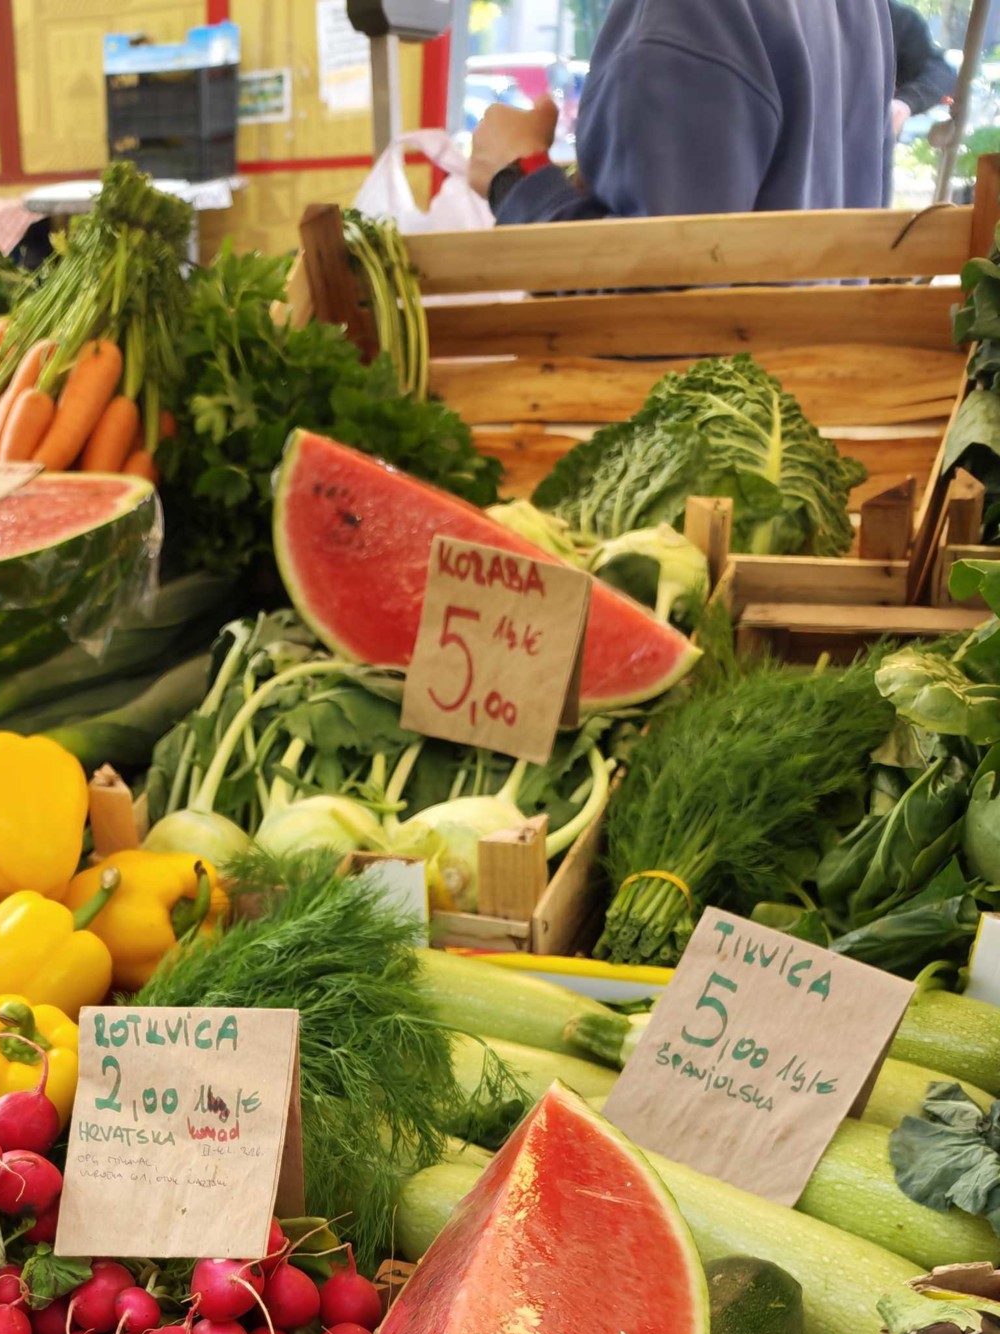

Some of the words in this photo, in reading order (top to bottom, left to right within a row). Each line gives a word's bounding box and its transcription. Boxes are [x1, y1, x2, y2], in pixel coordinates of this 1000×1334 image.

[438, 541, 546, 598] KORABA
[427, 605, 517, 728] 5,00
[713, 921, 833, 1002] TIKVICA
[681, 971, 769, 1068] 5,00
[95, 1055, 179, 1122] 2,00
[79, 1121, 176, 1146] HRVATSKA
